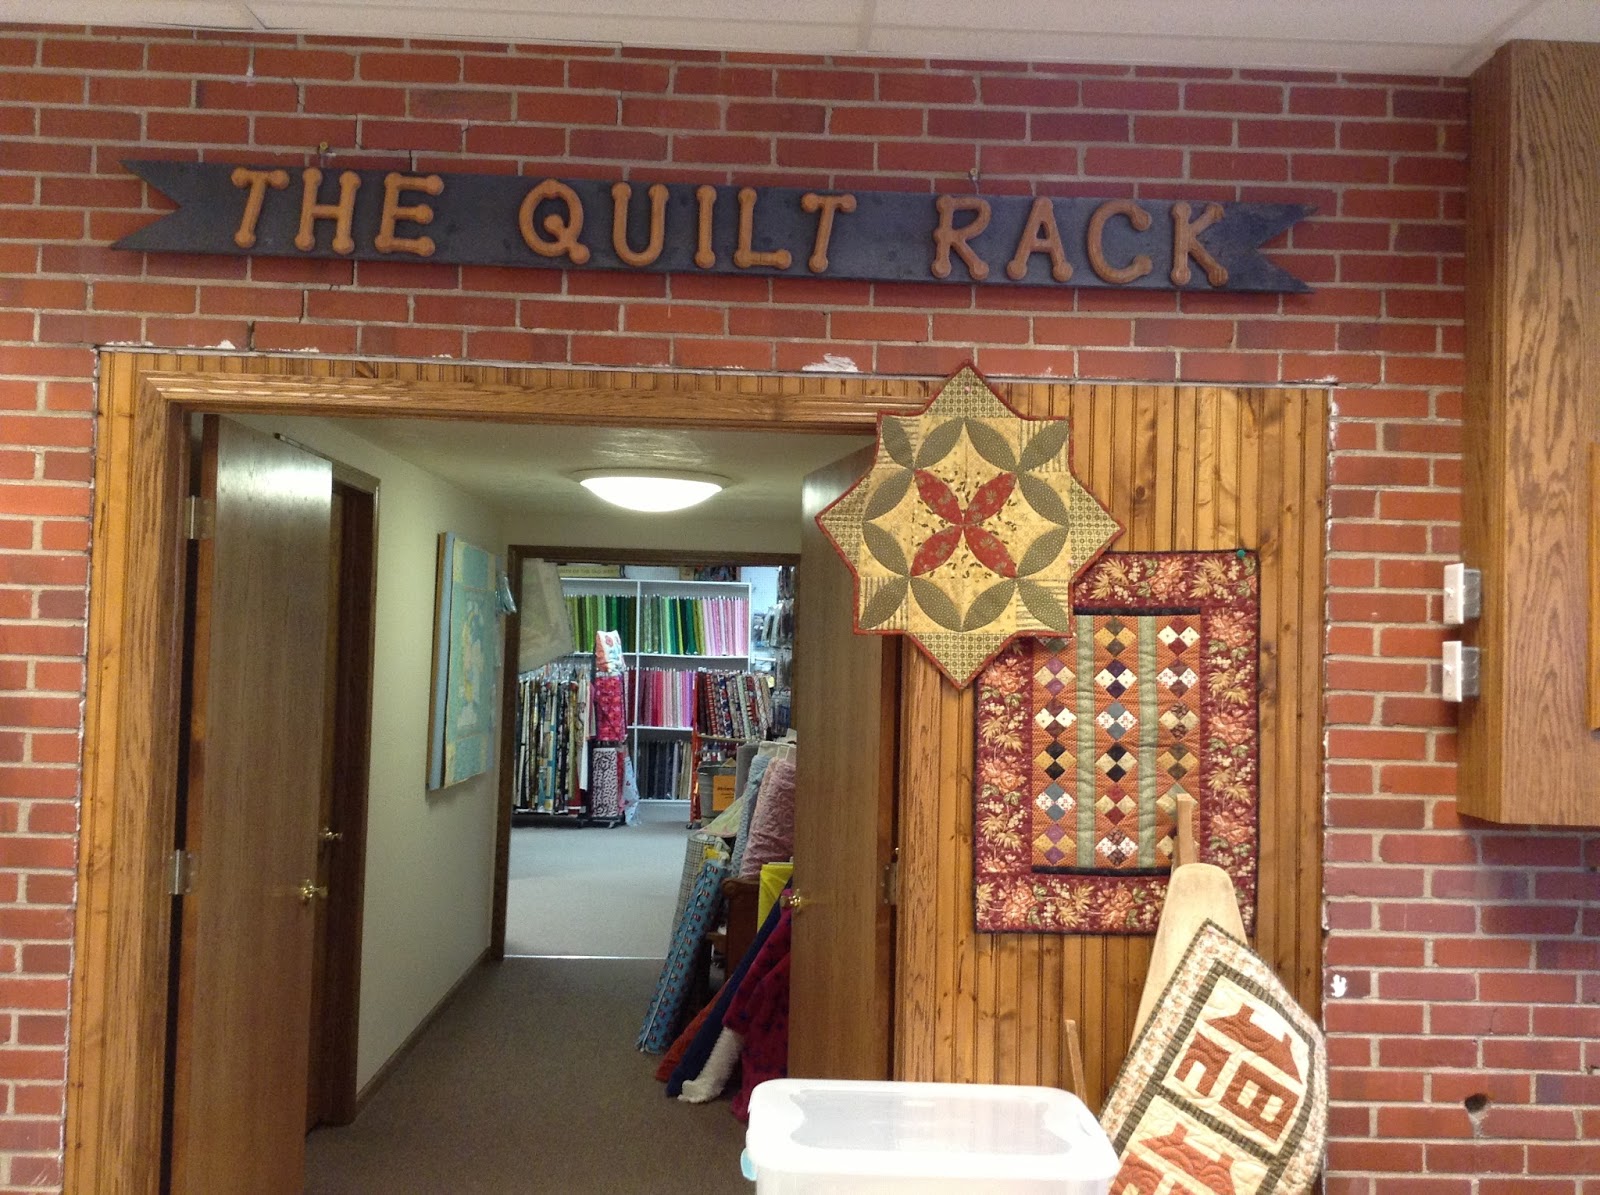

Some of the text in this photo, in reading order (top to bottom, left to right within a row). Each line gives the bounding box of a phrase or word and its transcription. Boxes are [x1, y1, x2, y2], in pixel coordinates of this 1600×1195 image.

[231, 167, 1229, 287] THE QUILT RACK
